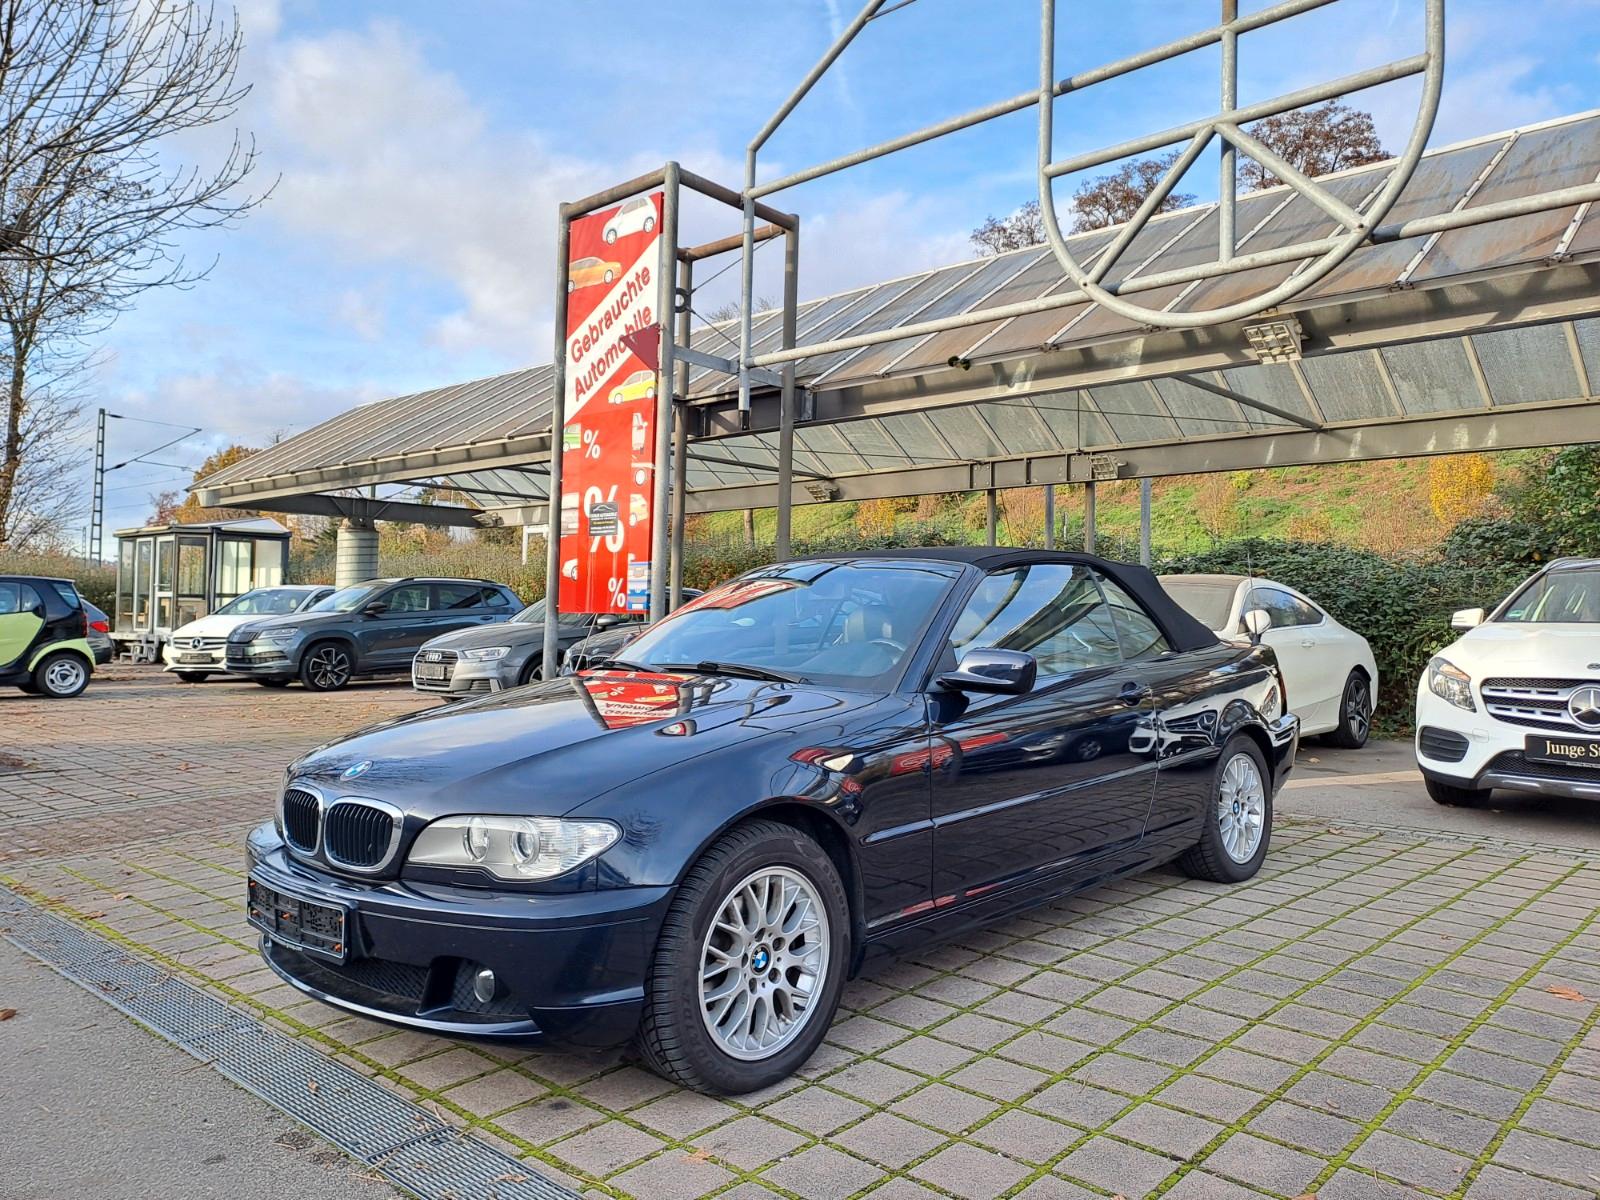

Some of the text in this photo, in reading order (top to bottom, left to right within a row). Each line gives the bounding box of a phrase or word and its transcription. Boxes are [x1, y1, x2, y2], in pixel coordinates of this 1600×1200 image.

[571, 266, 651, 363] Gebrauchte
[583, 429, 601, 459] %
[608, 577, 626, 608] %
[1545, 741, 1585, 758] Junge
